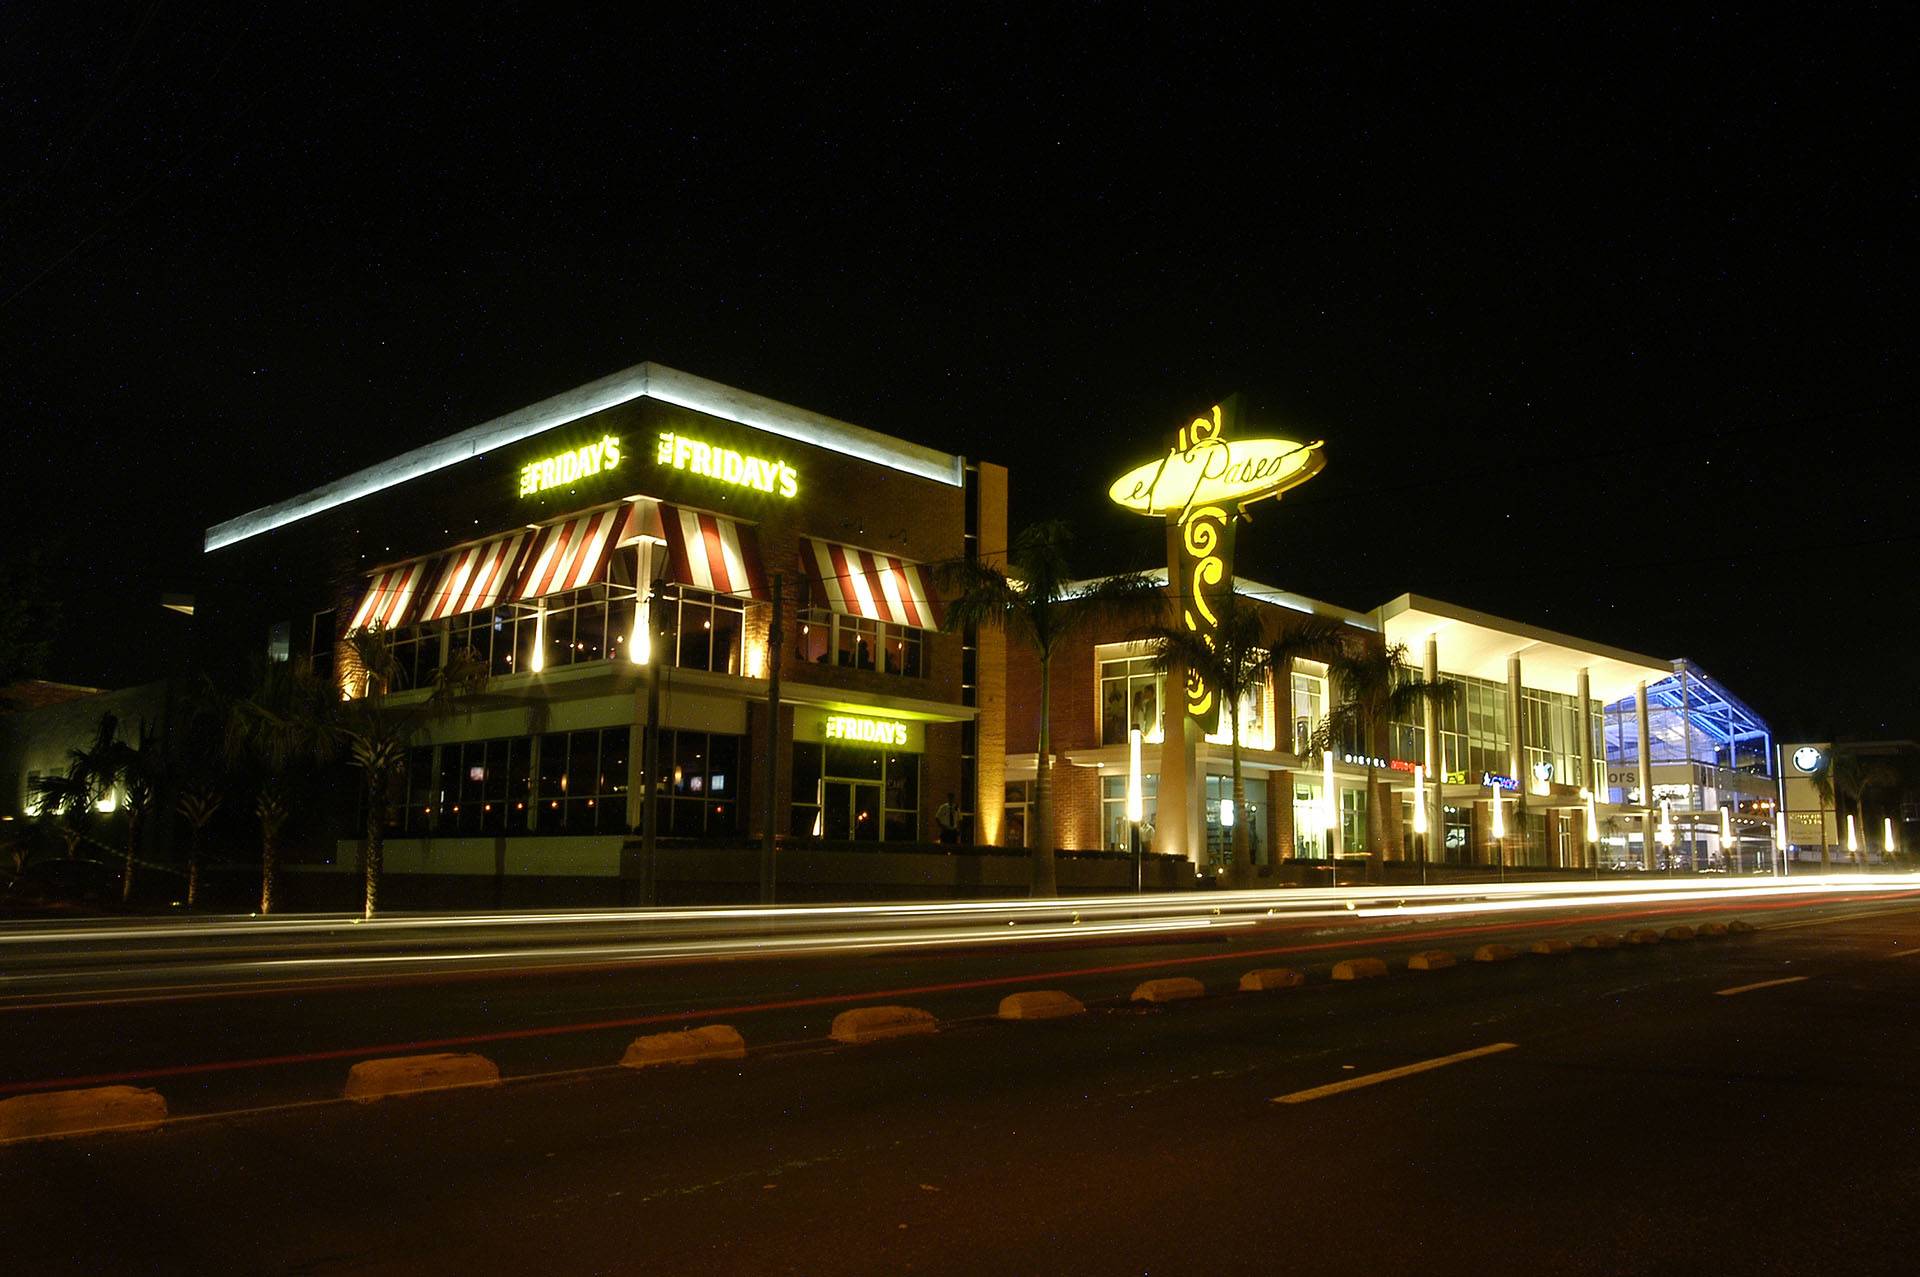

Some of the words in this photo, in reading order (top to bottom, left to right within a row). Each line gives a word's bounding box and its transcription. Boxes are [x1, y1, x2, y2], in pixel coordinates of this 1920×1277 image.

[530, 434, 620, 494] FRIDAY'S
[673, 435, 798, 499] FRIDAY'S
[1175, 437, 1324, 527] Paseo
[836, 717, 907, 746] FRIDAY'S
